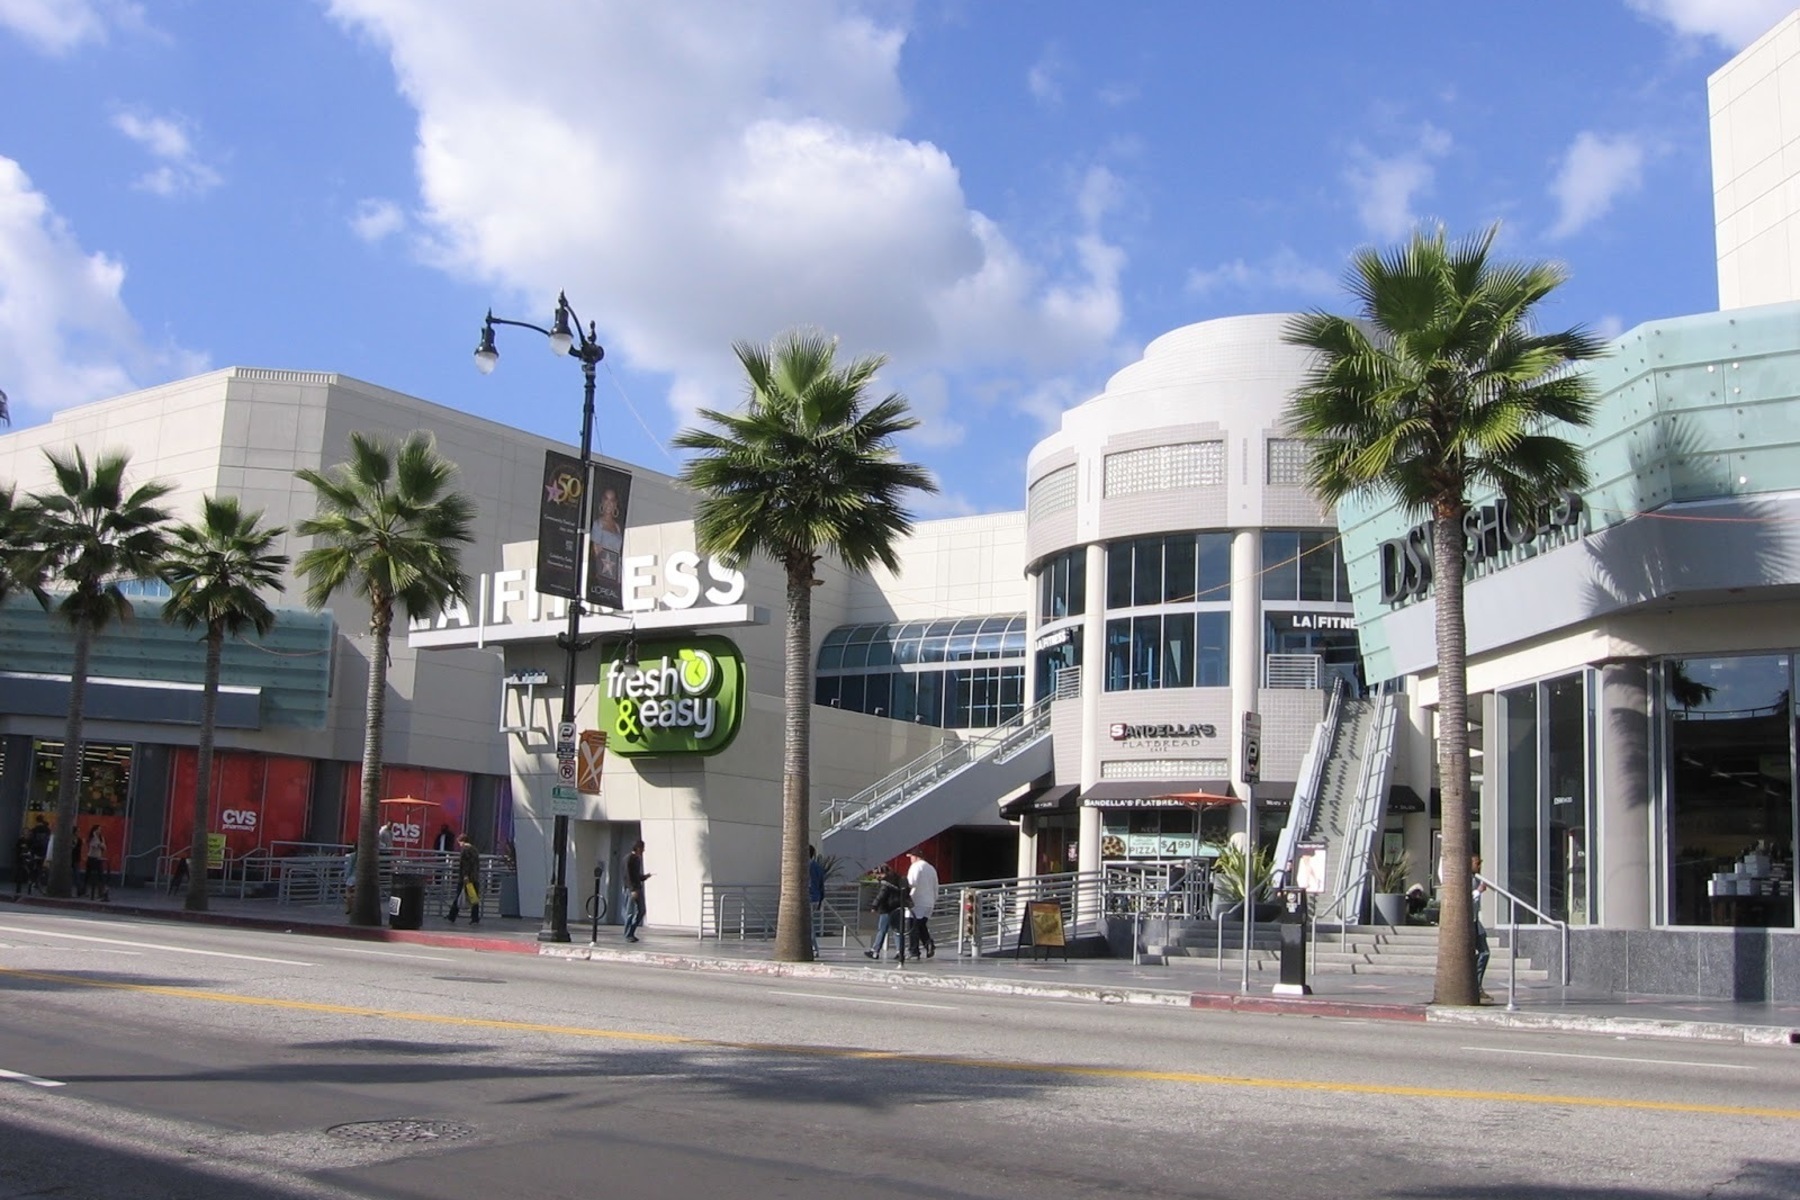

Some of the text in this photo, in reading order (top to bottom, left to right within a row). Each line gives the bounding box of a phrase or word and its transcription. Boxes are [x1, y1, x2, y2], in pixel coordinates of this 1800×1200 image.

[493, 551, 746, 624] FIESS
[606, 655, 679, 699] fresh
[615, 698, 716, 739] & easy
[1122, 739, 1200, 748] FLATBREAD
[222, 808, 257, 826] CVS
[222, 823, 255, 832] pharmacy
[391, 822, 421, 838] CVS
